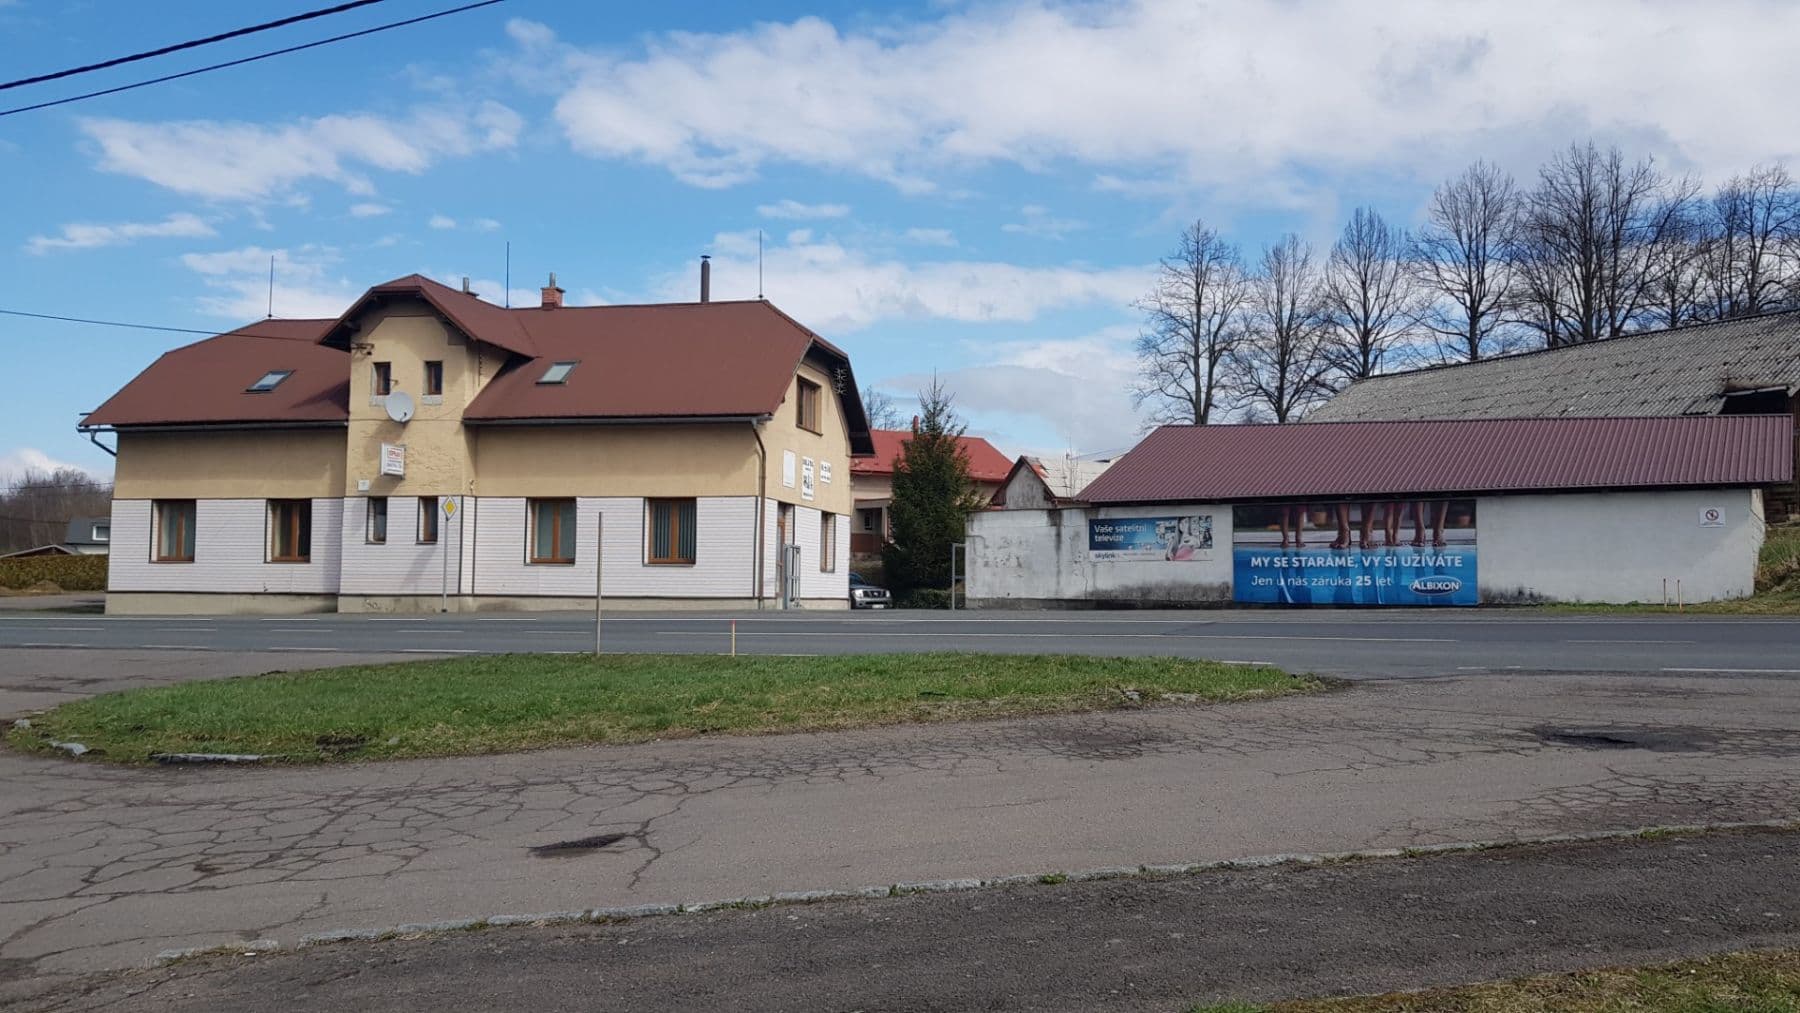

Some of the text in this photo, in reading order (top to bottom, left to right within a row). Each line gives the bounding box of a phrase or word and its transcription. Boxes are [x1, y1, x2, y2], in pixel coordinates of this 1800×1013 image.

[1094, 524, 1114, 533] Vaše
[1094, 533, 1124, 543] televize
[1251, 556, 1271, 568] MY
[1273, 556, 1289, 568] SE
[1291, 553, 1359, 569] STARÁME,
[1362, 555, 1382, 567] VY
[1384, 555, 1398, 567] SI
[1251, 575, 1393, 587] Jen u nás záruka 25 let
[1412, 579, 1460, 590] ALBIXON
